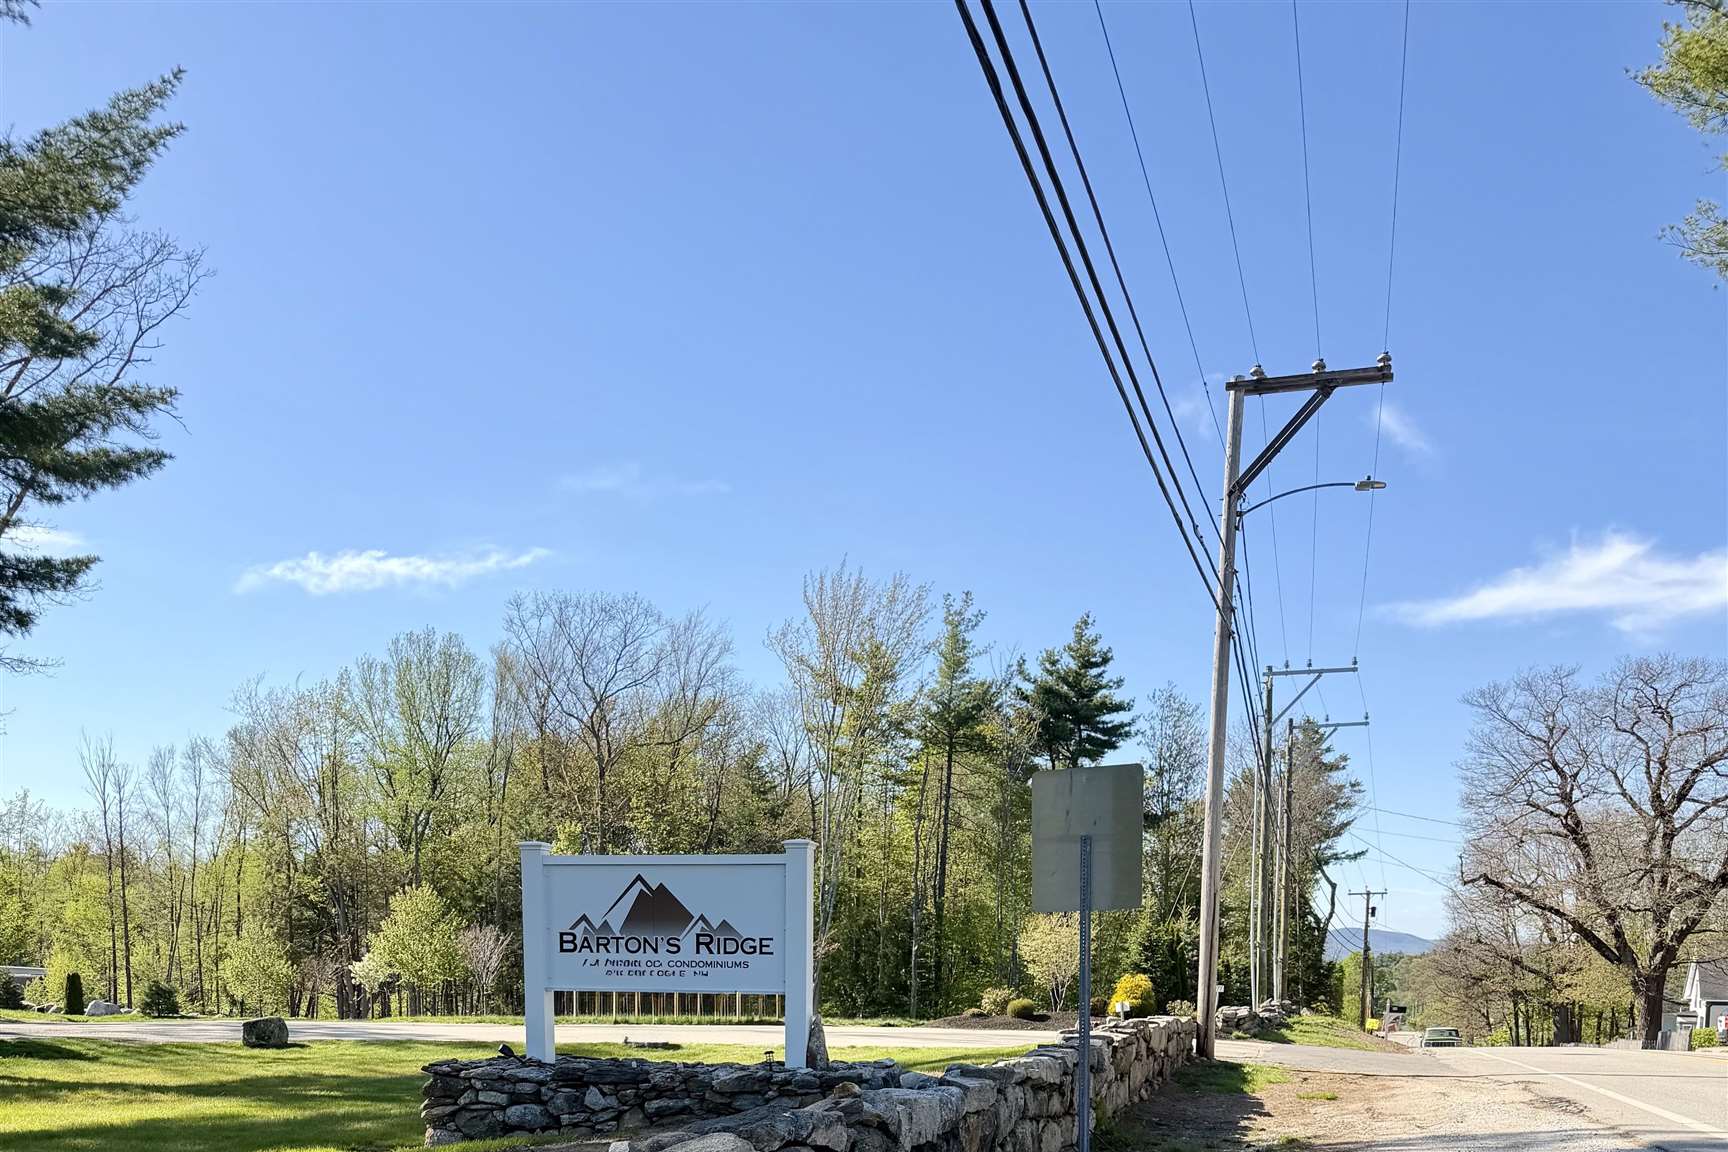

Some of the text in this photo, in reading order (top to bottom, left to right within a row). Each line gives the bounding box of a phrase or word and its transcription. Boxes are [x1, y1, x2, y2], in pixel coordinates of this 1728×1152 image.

[558, 931, 774, 955] BARTON'S RIDGE
[667, 960, 750, 969] CONDOMINIUMS
